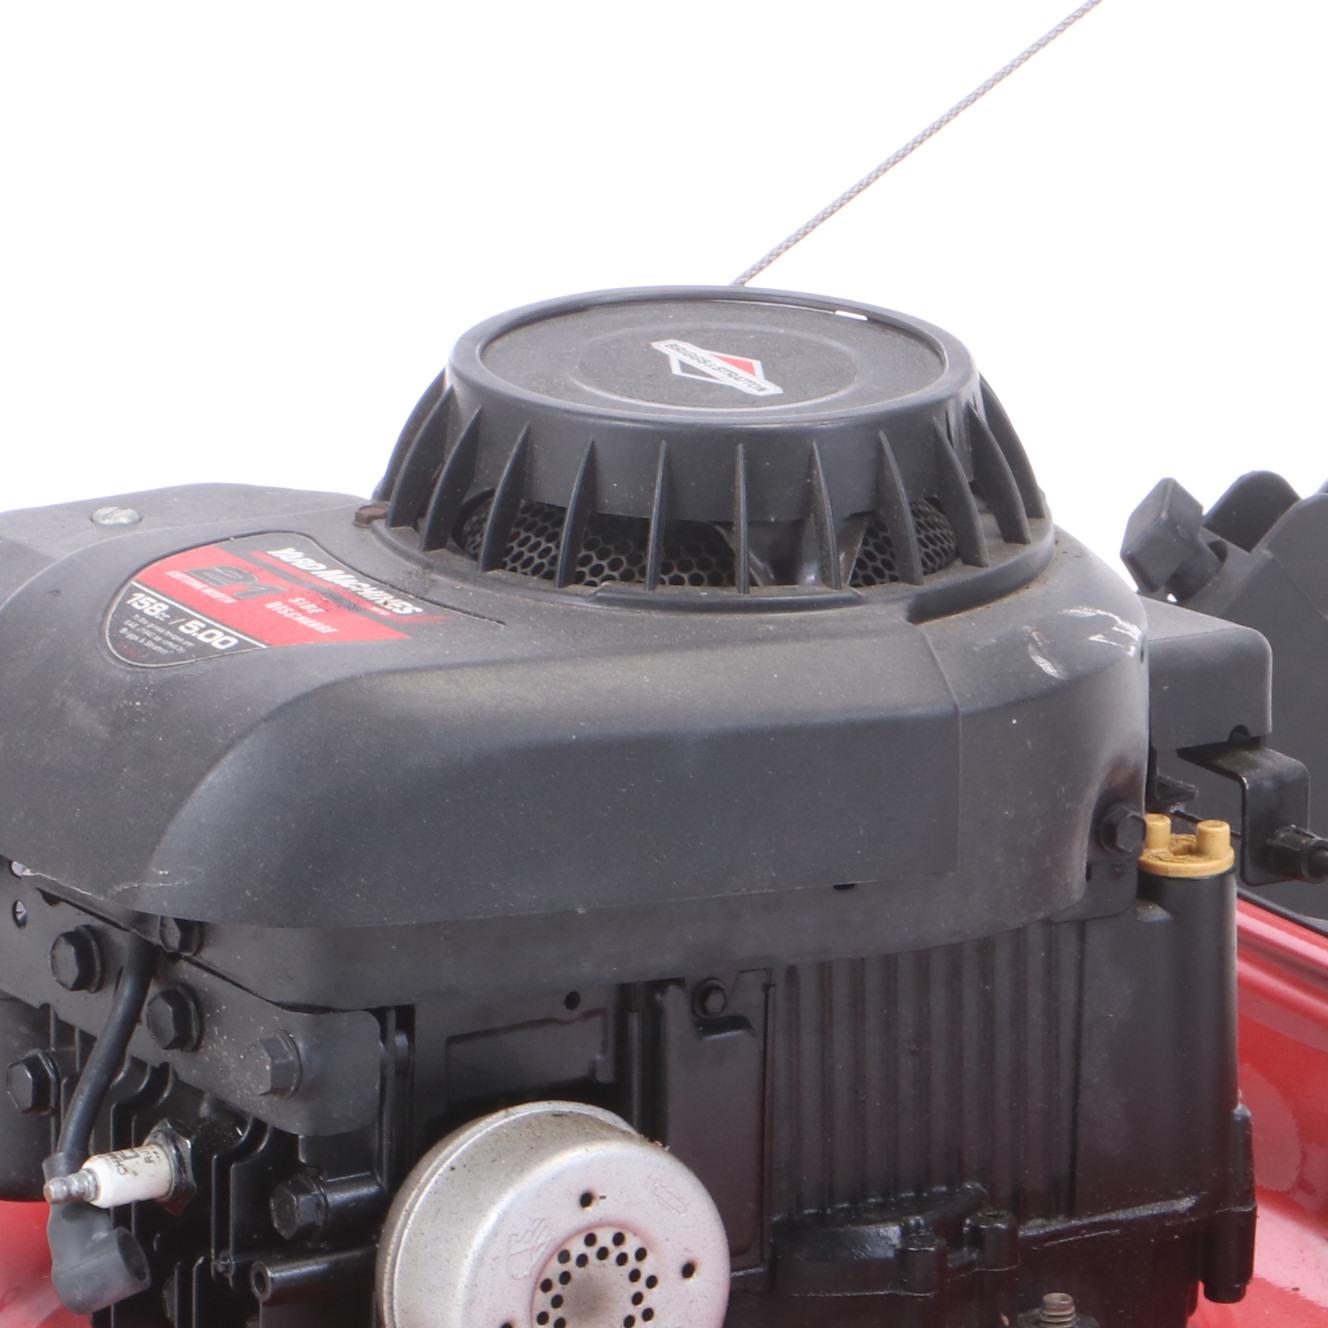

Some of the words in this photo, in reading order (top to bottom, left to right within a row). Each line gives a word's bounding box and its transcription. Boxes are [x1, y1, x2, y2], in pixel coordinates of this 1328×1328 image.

[184, 565, 288, 600] 21
[265, 547, 327, 571] YARD
[310, 569, 425, 616] MACHINES
[264, 601, 341, 635] DISCHARGE
[287, 596, 326, 615] SIDE
[178, 619, 240, 651] 5.00
